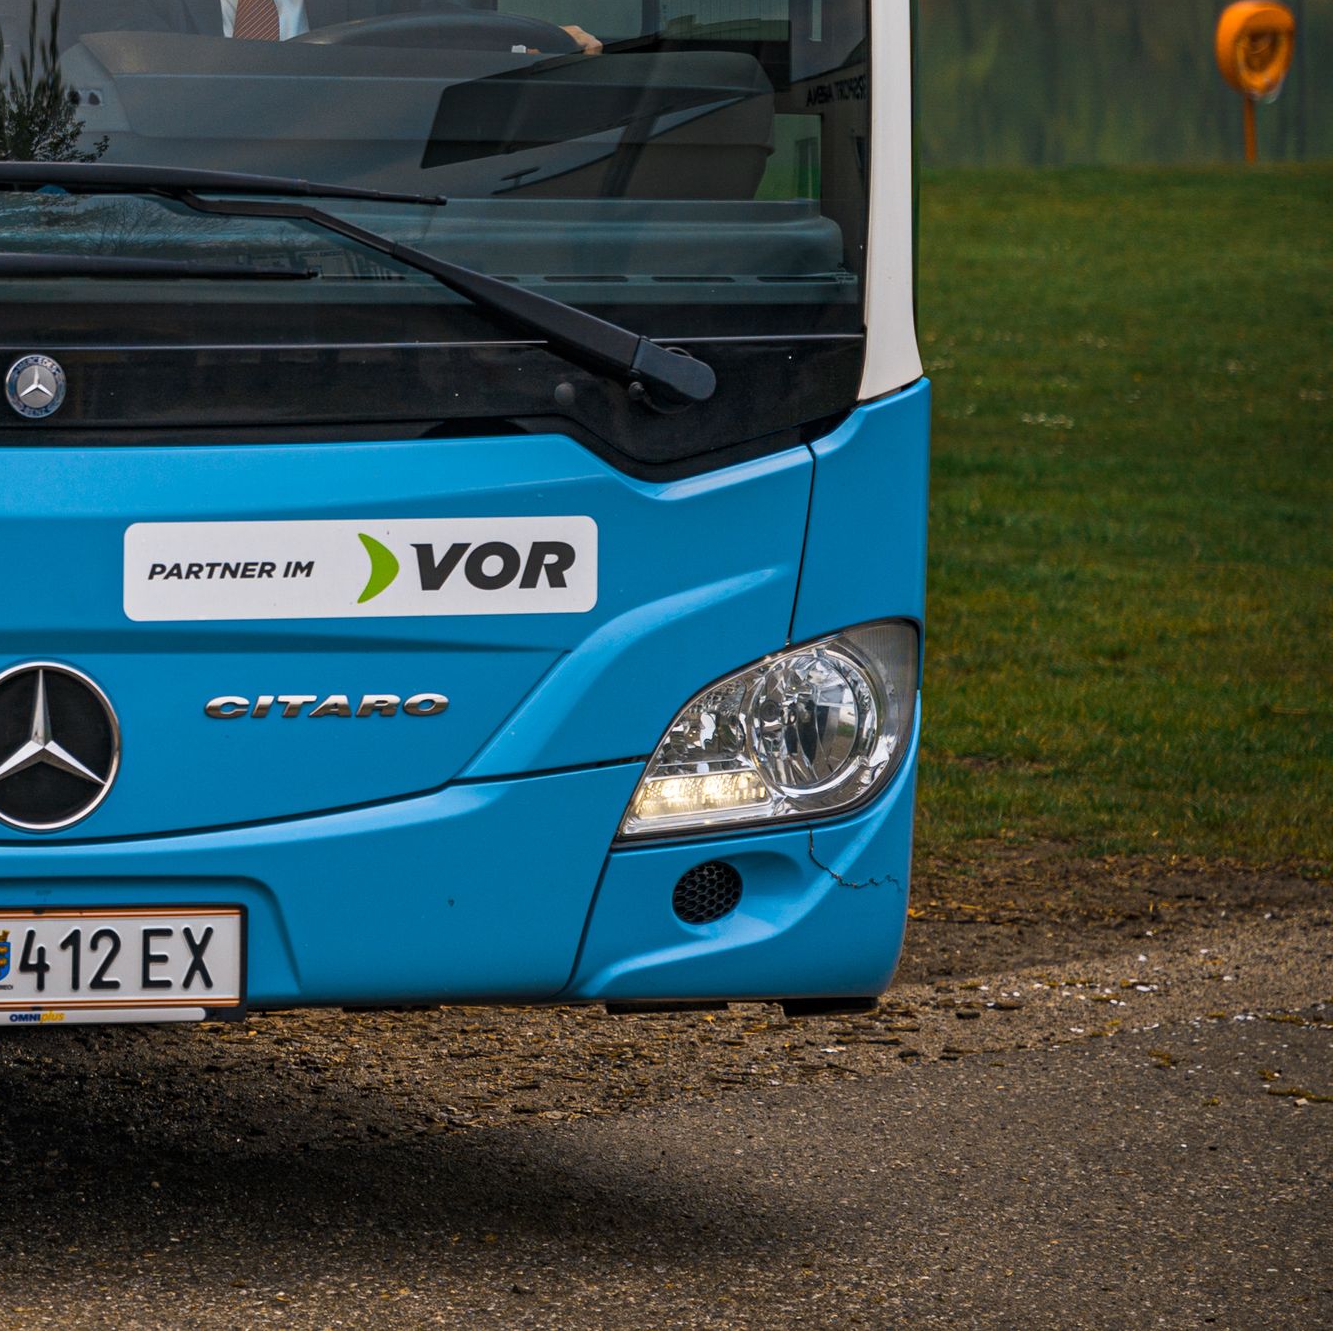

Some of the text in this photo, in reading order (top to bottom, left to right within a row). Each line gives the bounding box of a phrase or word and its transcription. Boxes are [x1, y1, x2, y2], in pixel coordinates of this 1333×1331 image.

[148, 561, 315, 582] PARTNER IM
[412, 541, 578, 592] VOR
[205, 692, 451, 718] CITARO
[19, 928, 123, 992] 412
[141, 927, 215, 990] EX
